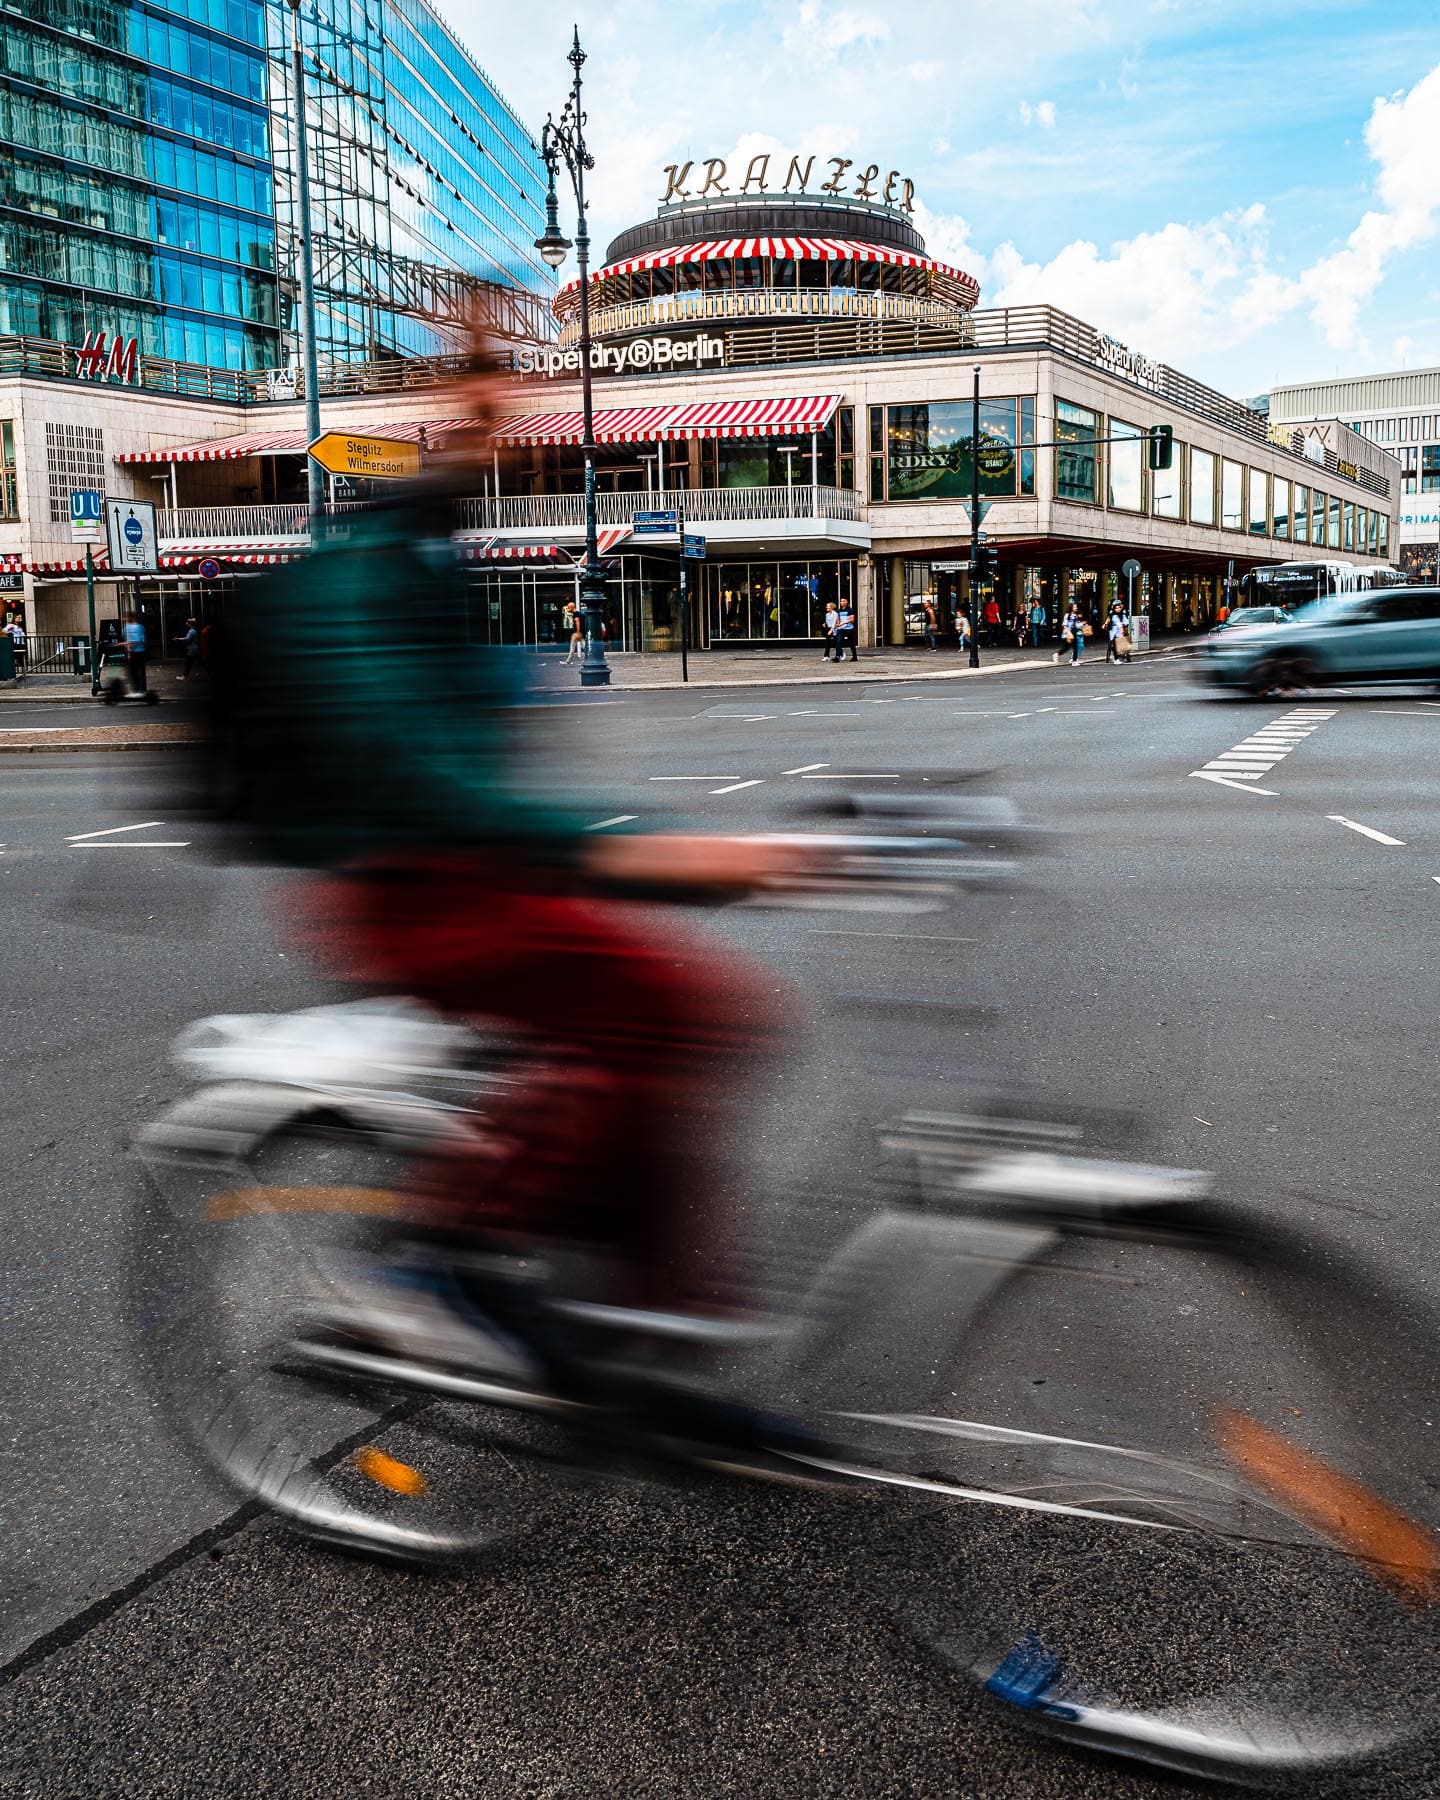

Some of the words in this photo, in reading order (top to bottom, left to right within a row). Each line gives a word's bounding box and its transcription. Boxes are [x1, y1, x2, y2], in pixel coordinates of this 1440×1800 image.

[658, 153, 916, 213] KRANZLER
[75, 330, 138, 384] H&M
[346, 441, 383, 458] Steglitz
[347, 457, 404, 473] Wilmersdorf
